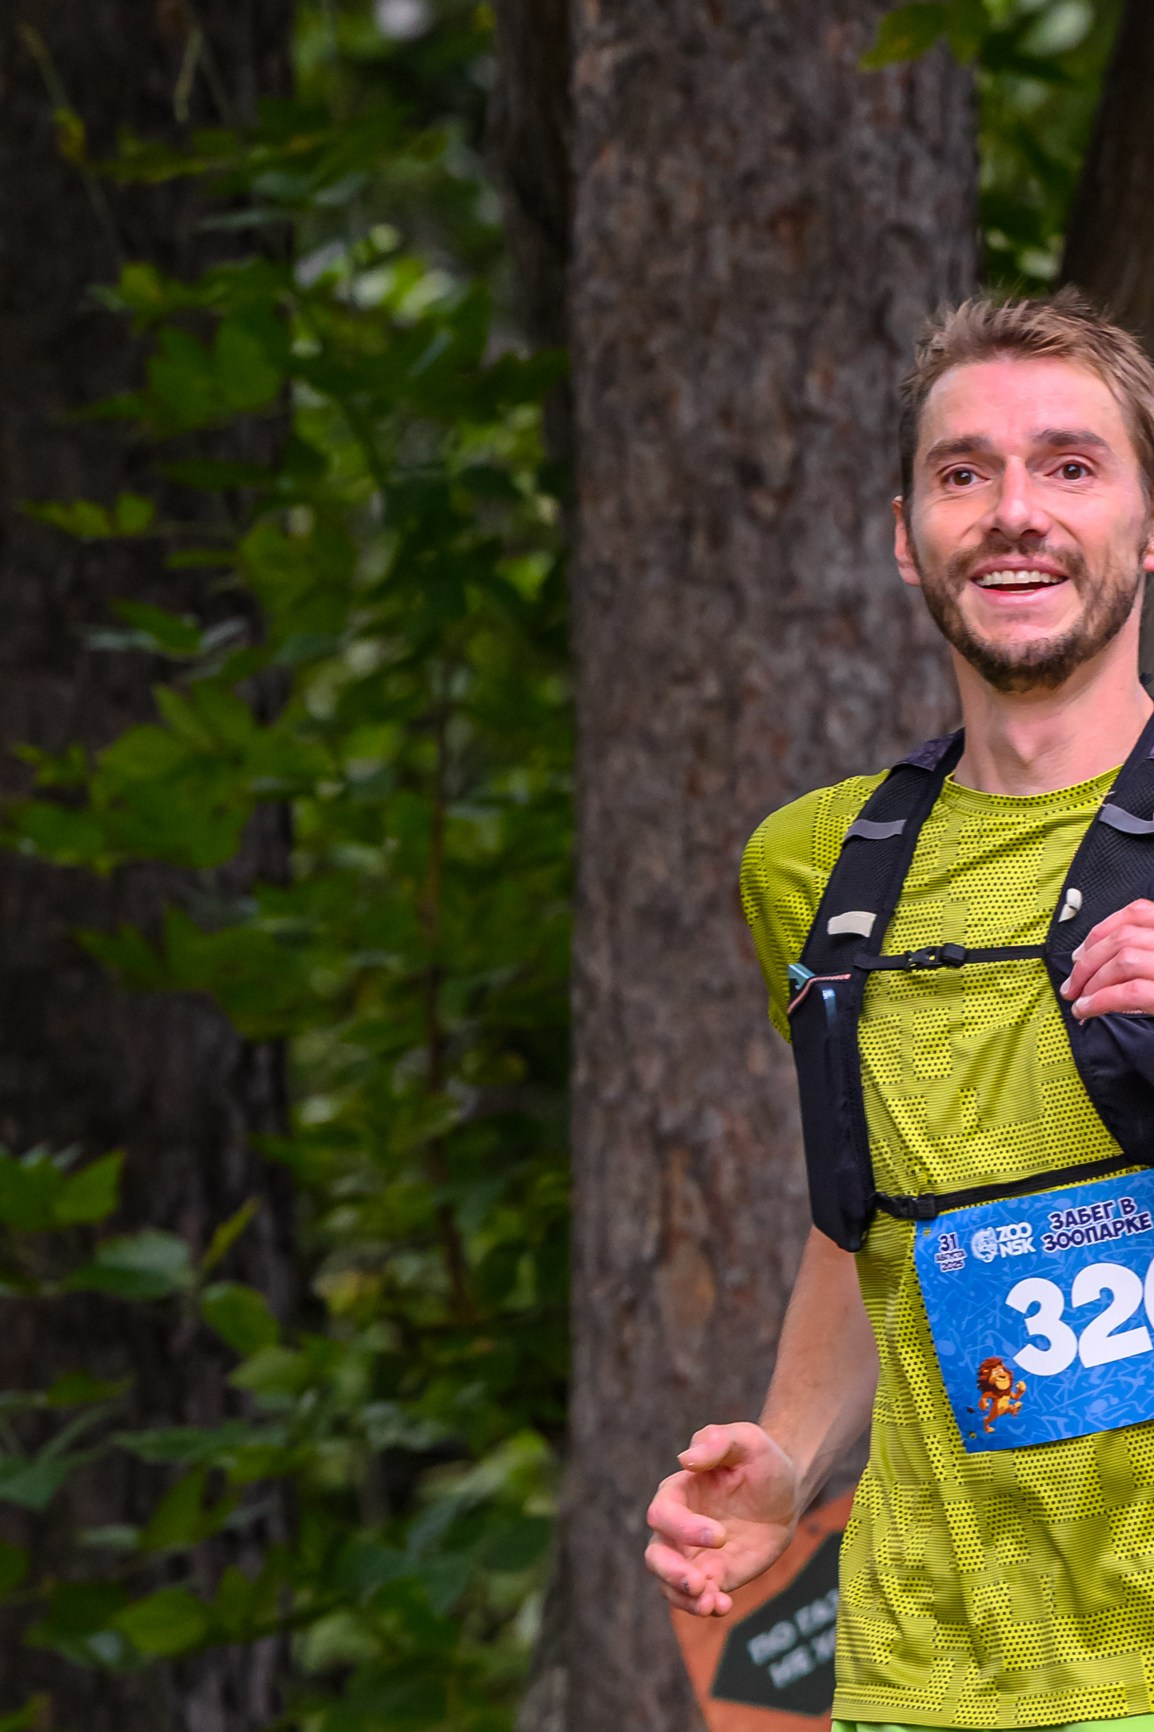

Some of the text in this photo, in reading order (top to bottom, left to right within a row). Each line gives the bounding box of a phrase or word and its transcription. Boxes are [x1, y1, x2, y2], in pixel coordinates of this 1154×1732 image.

[1049, 1198, 1136, 1230] ЗАБЕГ В
[940, 1233, 957, 1251] 31
[995, 1221, 1032, 1242] ZOO
[1042, 1212, 1153, 1251] ЗООПАРКЕ
[999, 1237, 1037, 1258] NSK
